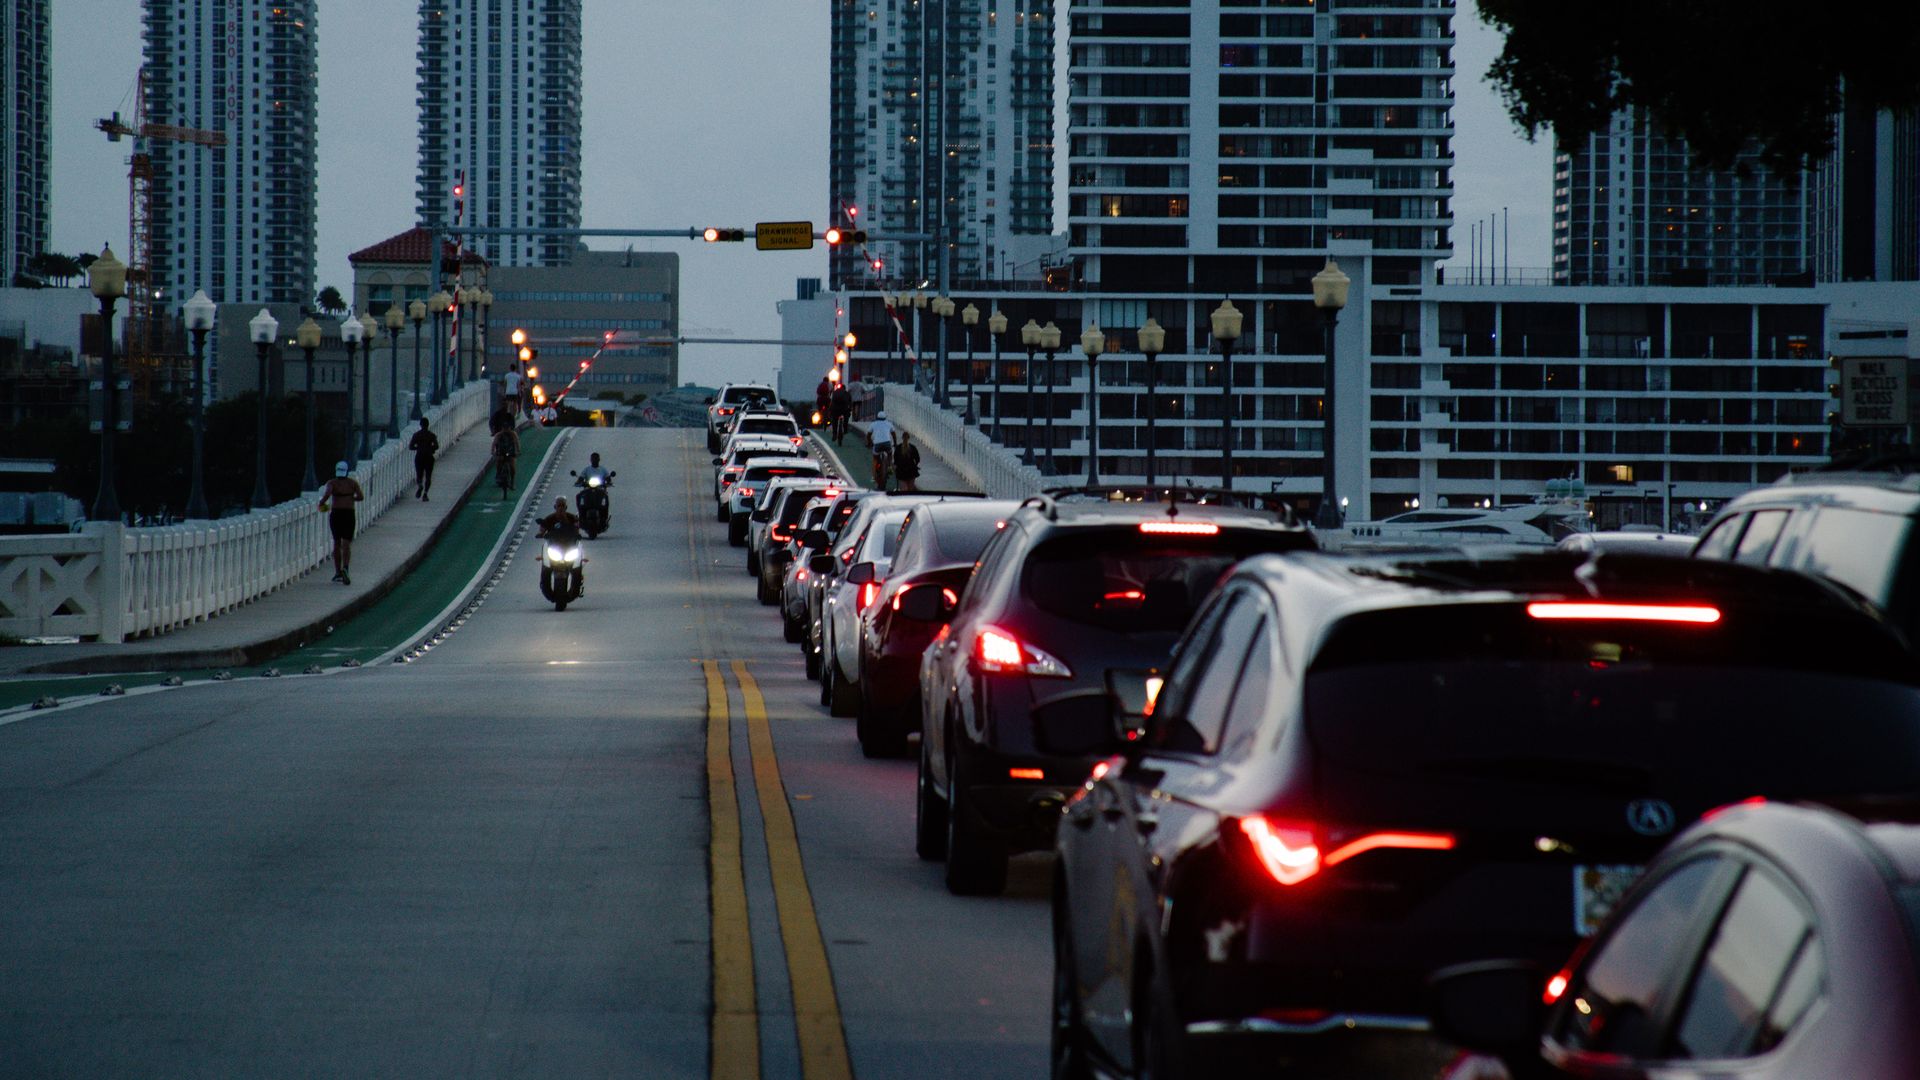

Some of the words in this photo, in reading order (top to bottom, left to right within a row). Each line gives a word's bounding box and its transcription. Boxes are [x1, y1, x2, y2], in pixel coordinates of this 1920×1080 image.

[759, 226, 809, 236] DRAWBRIDGE
[770, 237, 799, 245] SIGNAL
[1859, 362, 1886, 375] WALK
[1851, 377, 1898, 390] BICYCLES
[1854, 391, 1893, 404] ACROSS
[1856, 406, 1892, 419] BRIDGE
